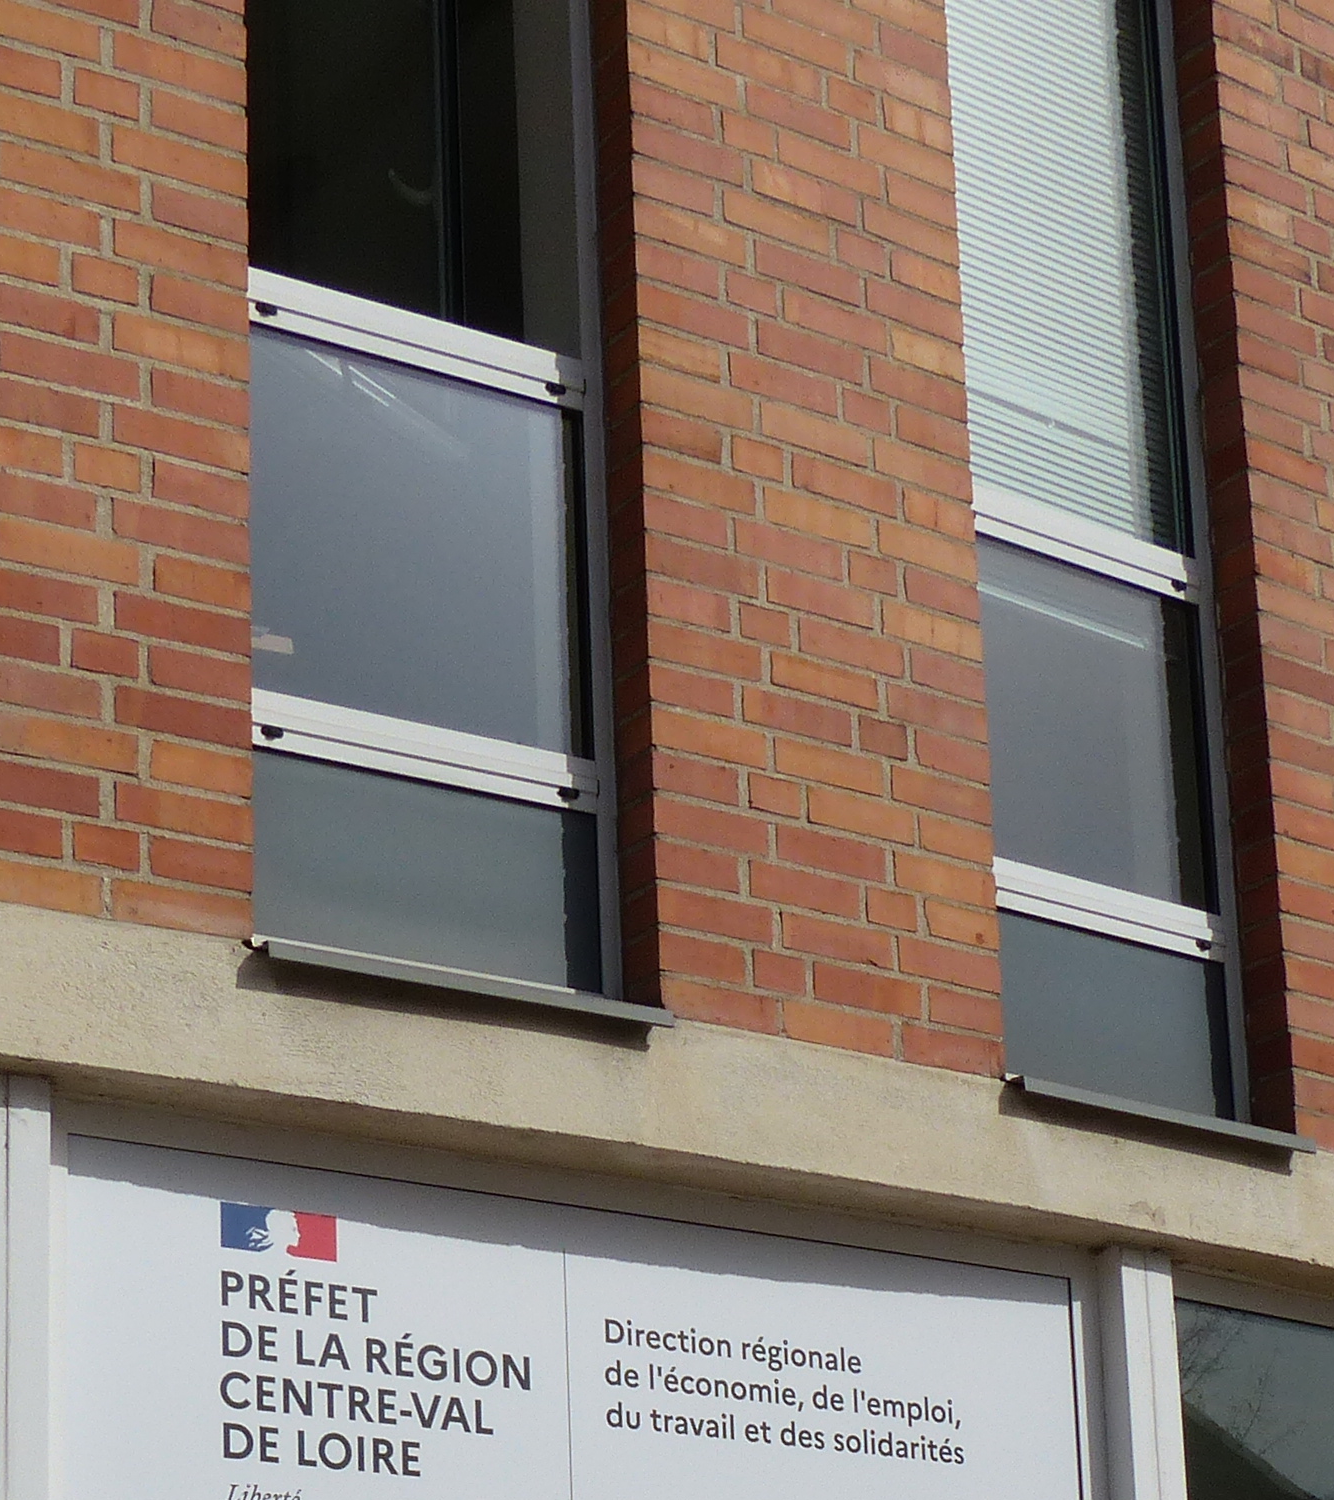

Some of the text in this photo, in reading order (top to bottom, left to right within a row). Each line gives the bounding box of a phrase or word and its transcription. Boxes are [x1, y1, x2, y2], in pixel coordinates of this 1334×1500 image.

[220, 1269, 378, 1324] PRÉFET
[221, 1320, 531, 1391] DE LA RÉGION
[604, 1318, 862, 1375] Direction régionale
[219, 1371, 494, 1436] CENTRE-VAL
[604, 1359, 961, 1430] de l'économie, de l'emploi,
[222, 1421, 421, 1478] DE LOIRE
[606, 1400, 965, 1465] du travail et des solidarités
